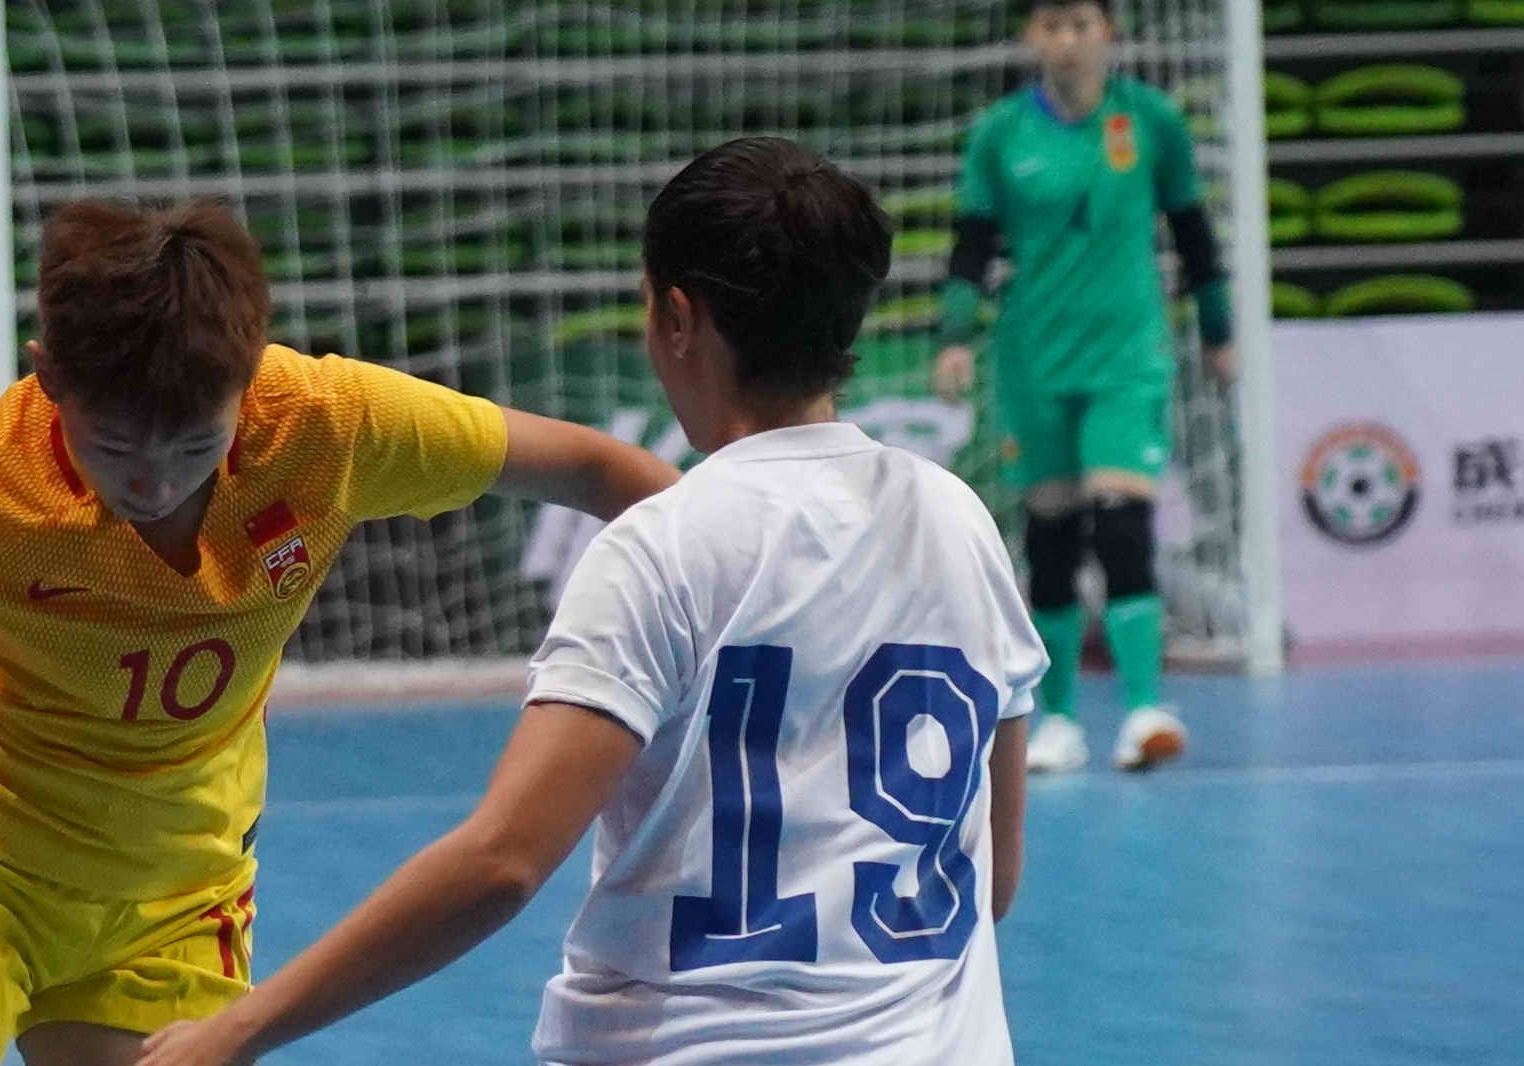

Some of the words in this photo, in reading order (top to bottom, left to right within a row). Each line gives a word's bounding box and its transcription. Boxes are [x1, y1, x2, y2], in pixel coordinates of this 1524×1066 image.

[265, 537, 304, 569] CFA
[120, 637, 235, 722] 10
[669, 642, 999, 971] 19
